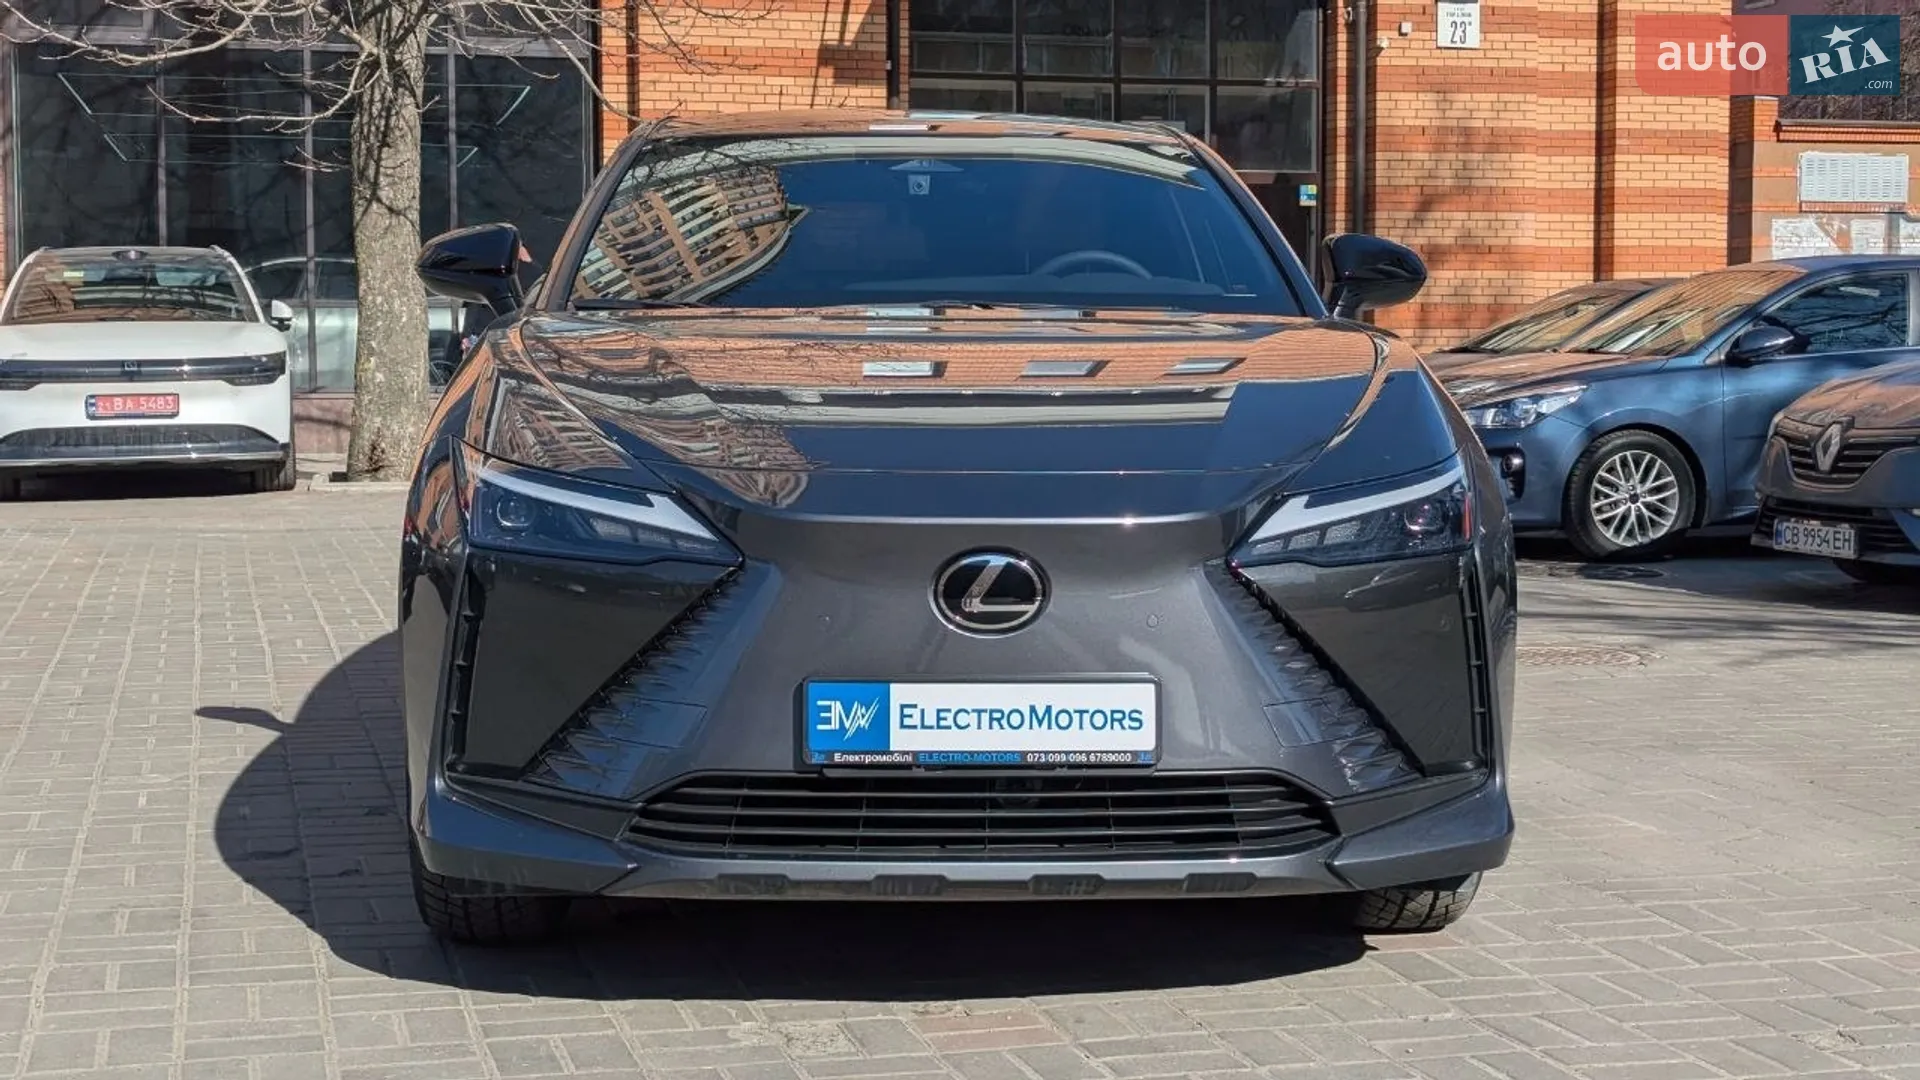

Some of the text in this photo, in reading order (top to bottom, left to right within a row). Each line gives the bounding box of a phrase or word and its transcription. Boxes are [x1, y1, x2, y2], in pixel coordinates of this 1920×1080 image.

[139, 395, 174, 409] 5483
[1783, 525, 1852, 551] CB 9954 EH
[833, 752, 912, 764] Електромобілі
[919, 753, 1021, 763] ELECTRO-MOTORS
[1026, 753, 1045, 762] 073
[1048, 753, 1066, 762] 099
[1089, 753, 1132, 762] 6789000
